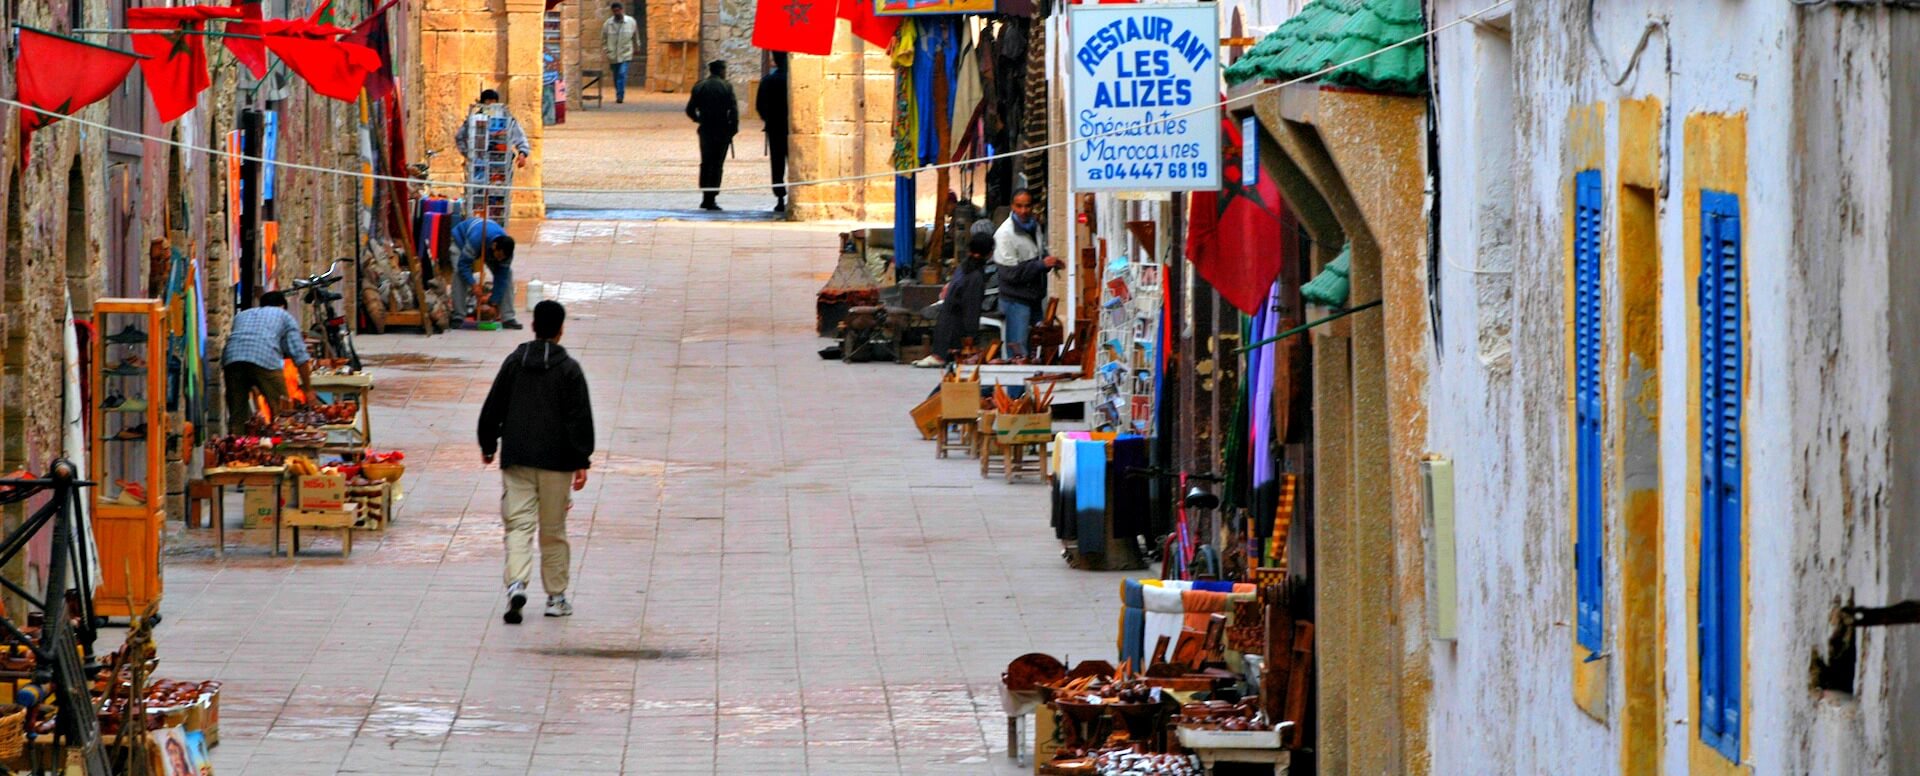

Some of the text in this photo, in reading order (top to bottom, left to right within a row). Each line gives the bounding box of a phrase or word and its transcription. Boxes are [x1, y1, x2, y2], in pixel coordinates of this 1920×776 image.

[1076, 16, 1213, 77] RESTAURANT
[1117, 50, 1169, 78] LES
[1094, 74, 1192, 109] ALIZÉS
[1080, 138, 1200, 161] Marocaines
